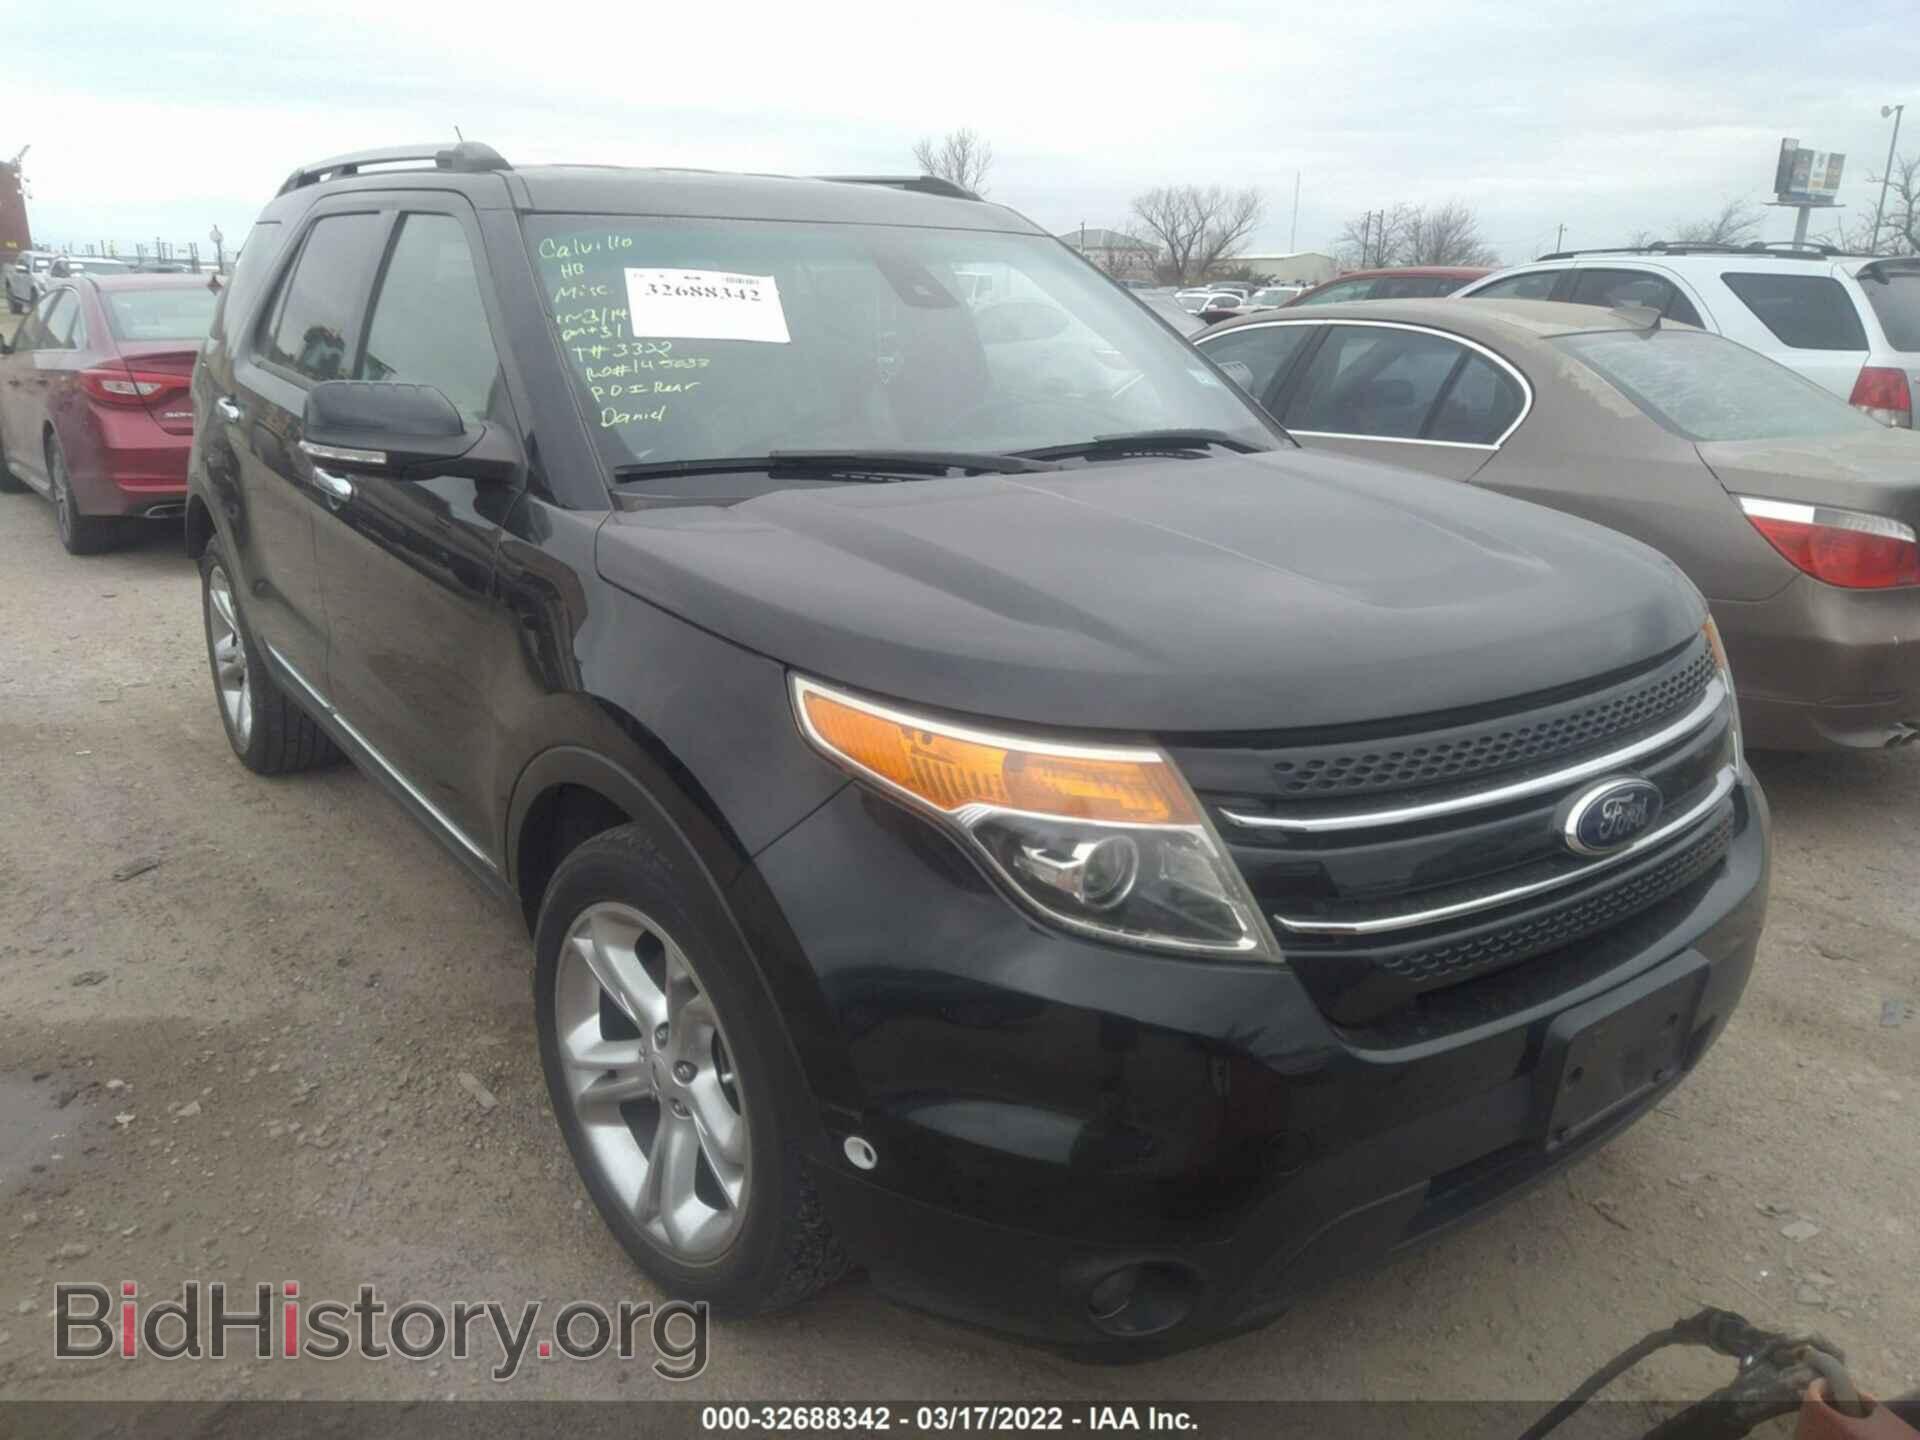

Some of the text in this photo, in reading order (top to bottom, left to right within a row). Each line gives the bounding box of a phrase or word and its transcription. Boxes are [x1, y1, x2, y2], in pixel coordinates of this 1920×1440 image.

[645, 283, 762, 303] 32688342
[600, 404, 666, 428] Daniel
[1600, 792, 1648, 839] Ford
